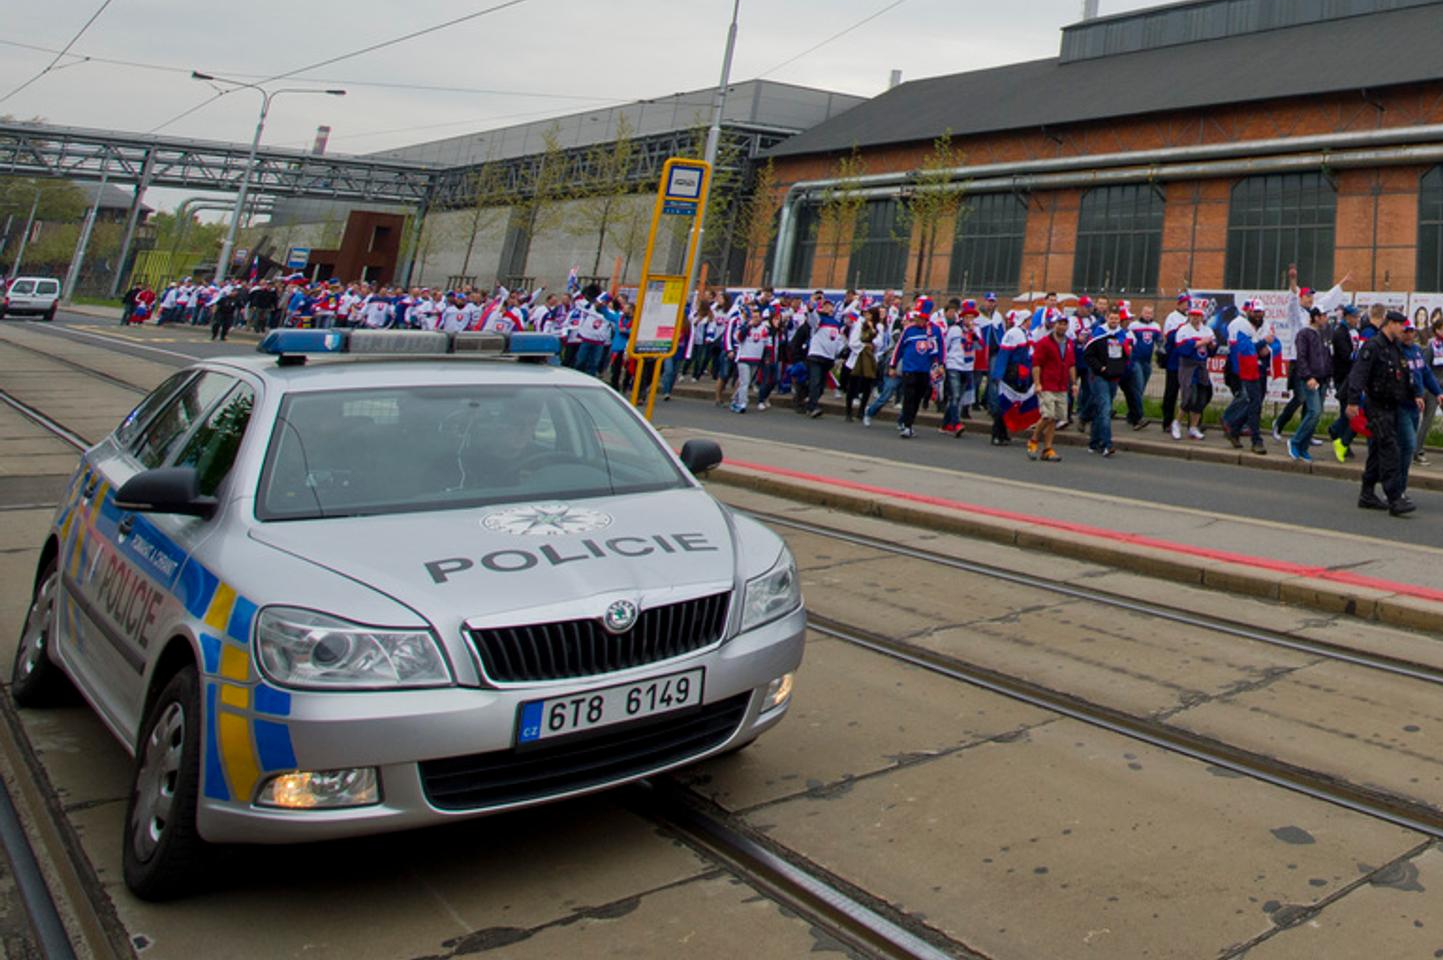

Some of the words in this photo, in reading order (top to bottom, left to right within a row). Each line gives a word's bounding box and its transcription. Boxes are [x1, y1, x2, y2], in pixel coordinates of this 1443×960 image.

[424, 533, 719, 584] POLICIE
[97, 554, 165, 650] POLICIE
[549, 695, 605, 731] 6T8
[626, 676, 690, 715] 6149
[522, 725, 539, 738] CZ
